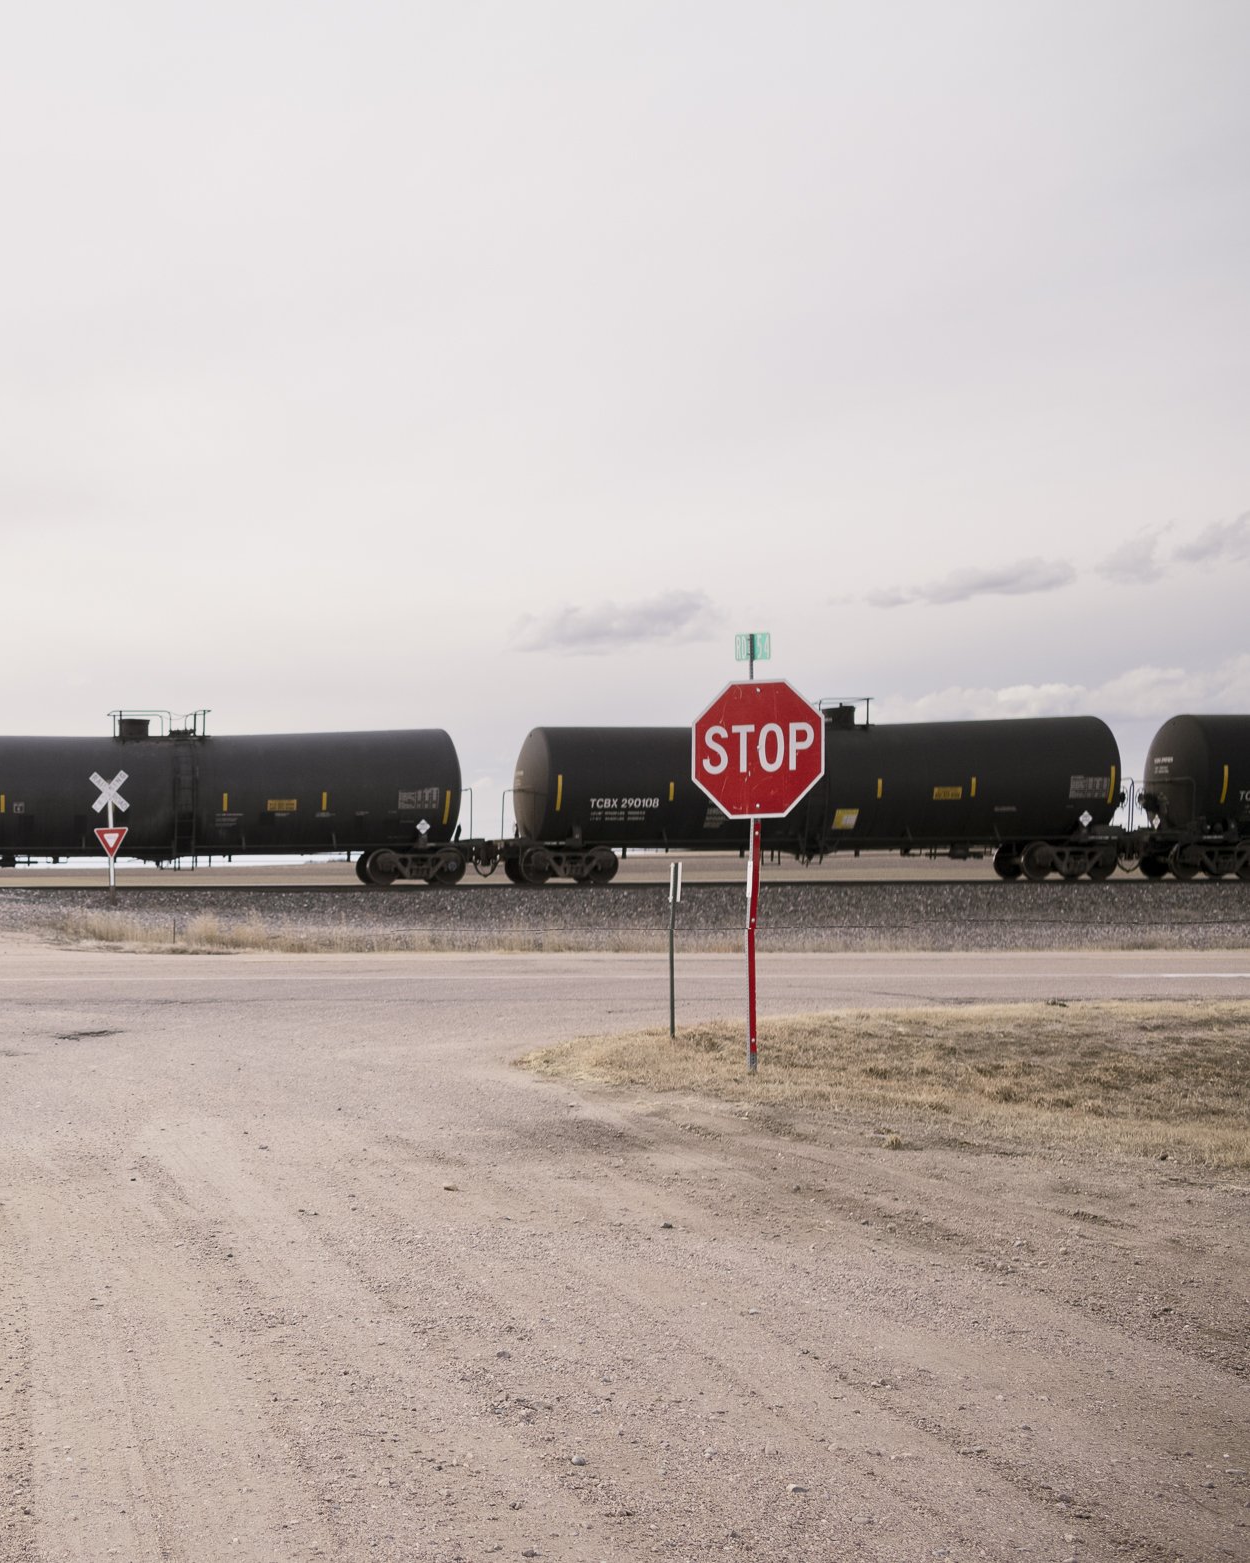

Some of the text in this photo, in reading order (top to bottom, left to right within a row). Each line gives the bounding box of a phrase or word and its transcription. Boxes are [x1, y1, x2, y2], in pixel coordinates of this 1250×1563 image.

[735, 634, 770, 659] RD 54
[702, 721, 815, 776] STOP
[589, 797, 660, 809] TCBX 290108
